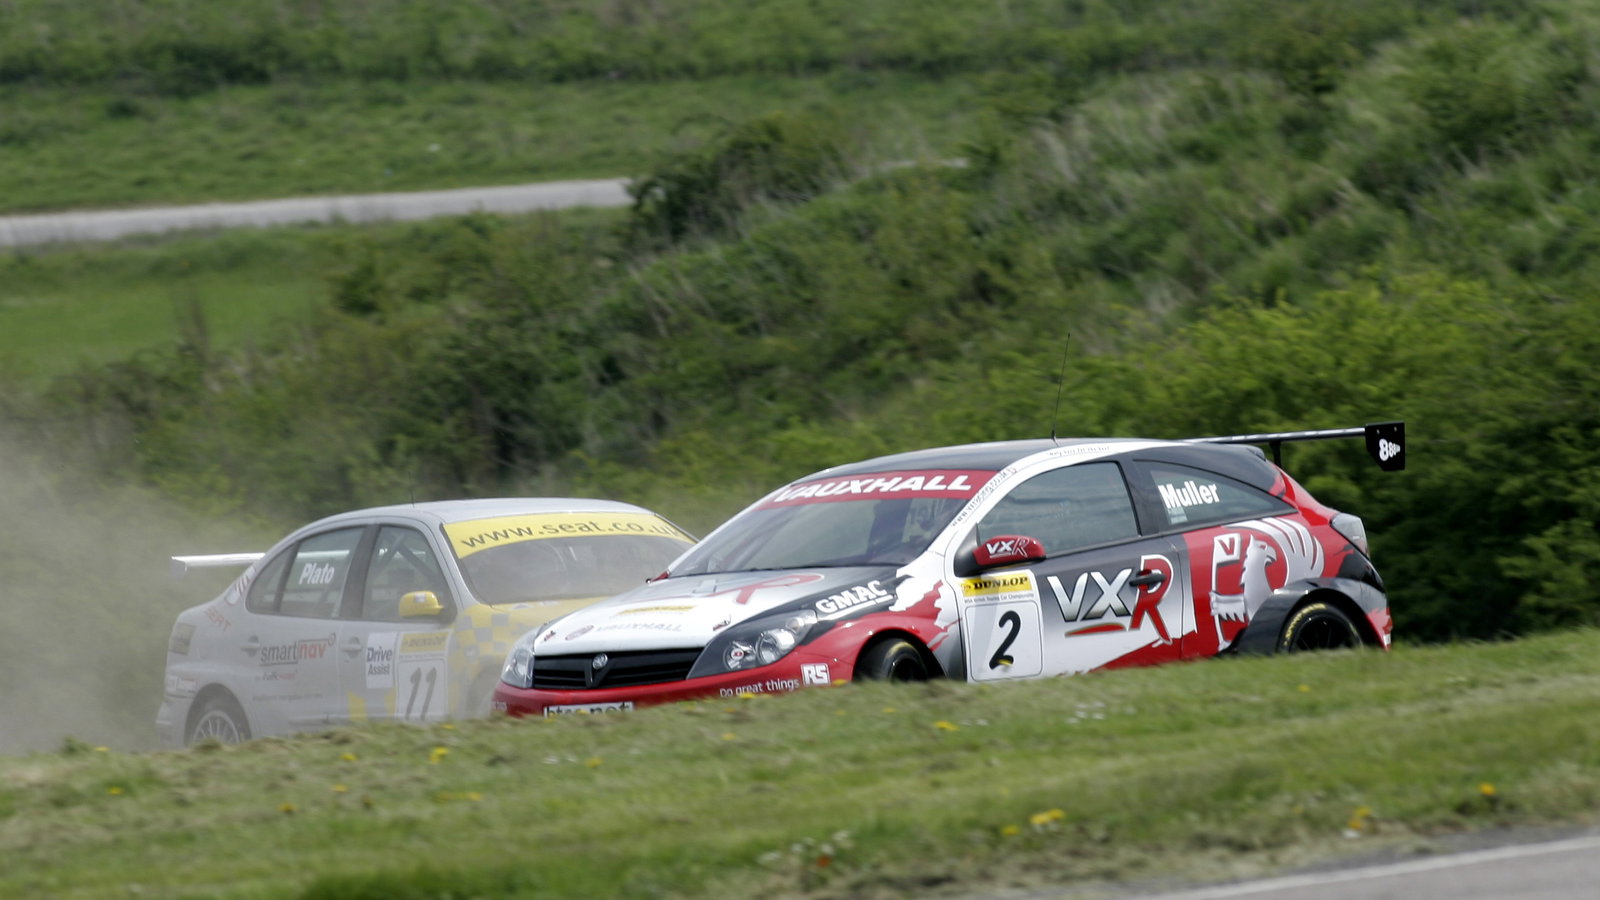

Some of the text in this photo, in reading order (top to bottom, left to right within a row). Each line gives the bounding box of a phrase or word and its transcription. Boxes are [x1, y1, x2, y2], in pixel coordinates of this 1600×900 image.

[774, 474, 972, 502] VAUXHALL
[1157, 480, 1220, 509] Muller
[461, 520, 680, 548] www.seat.co.uk
[986, 536, 1030, 558] VXR
[299, 562, 335, 585] Plato
[974, 576, 1028, 590] DUNLOP
[815, 580, 889, 614] GMAC
[1046, 553, 1174, 646] VXR
[989, 610, 1021, 670] 2
[366, 645, 393, 663] Drive
[367, 664, 391, 676] Assist
[803, 665, 829, 685] RS
[405, 667, 437, 721] 11
[720, 678, 800, 698] Do great things
